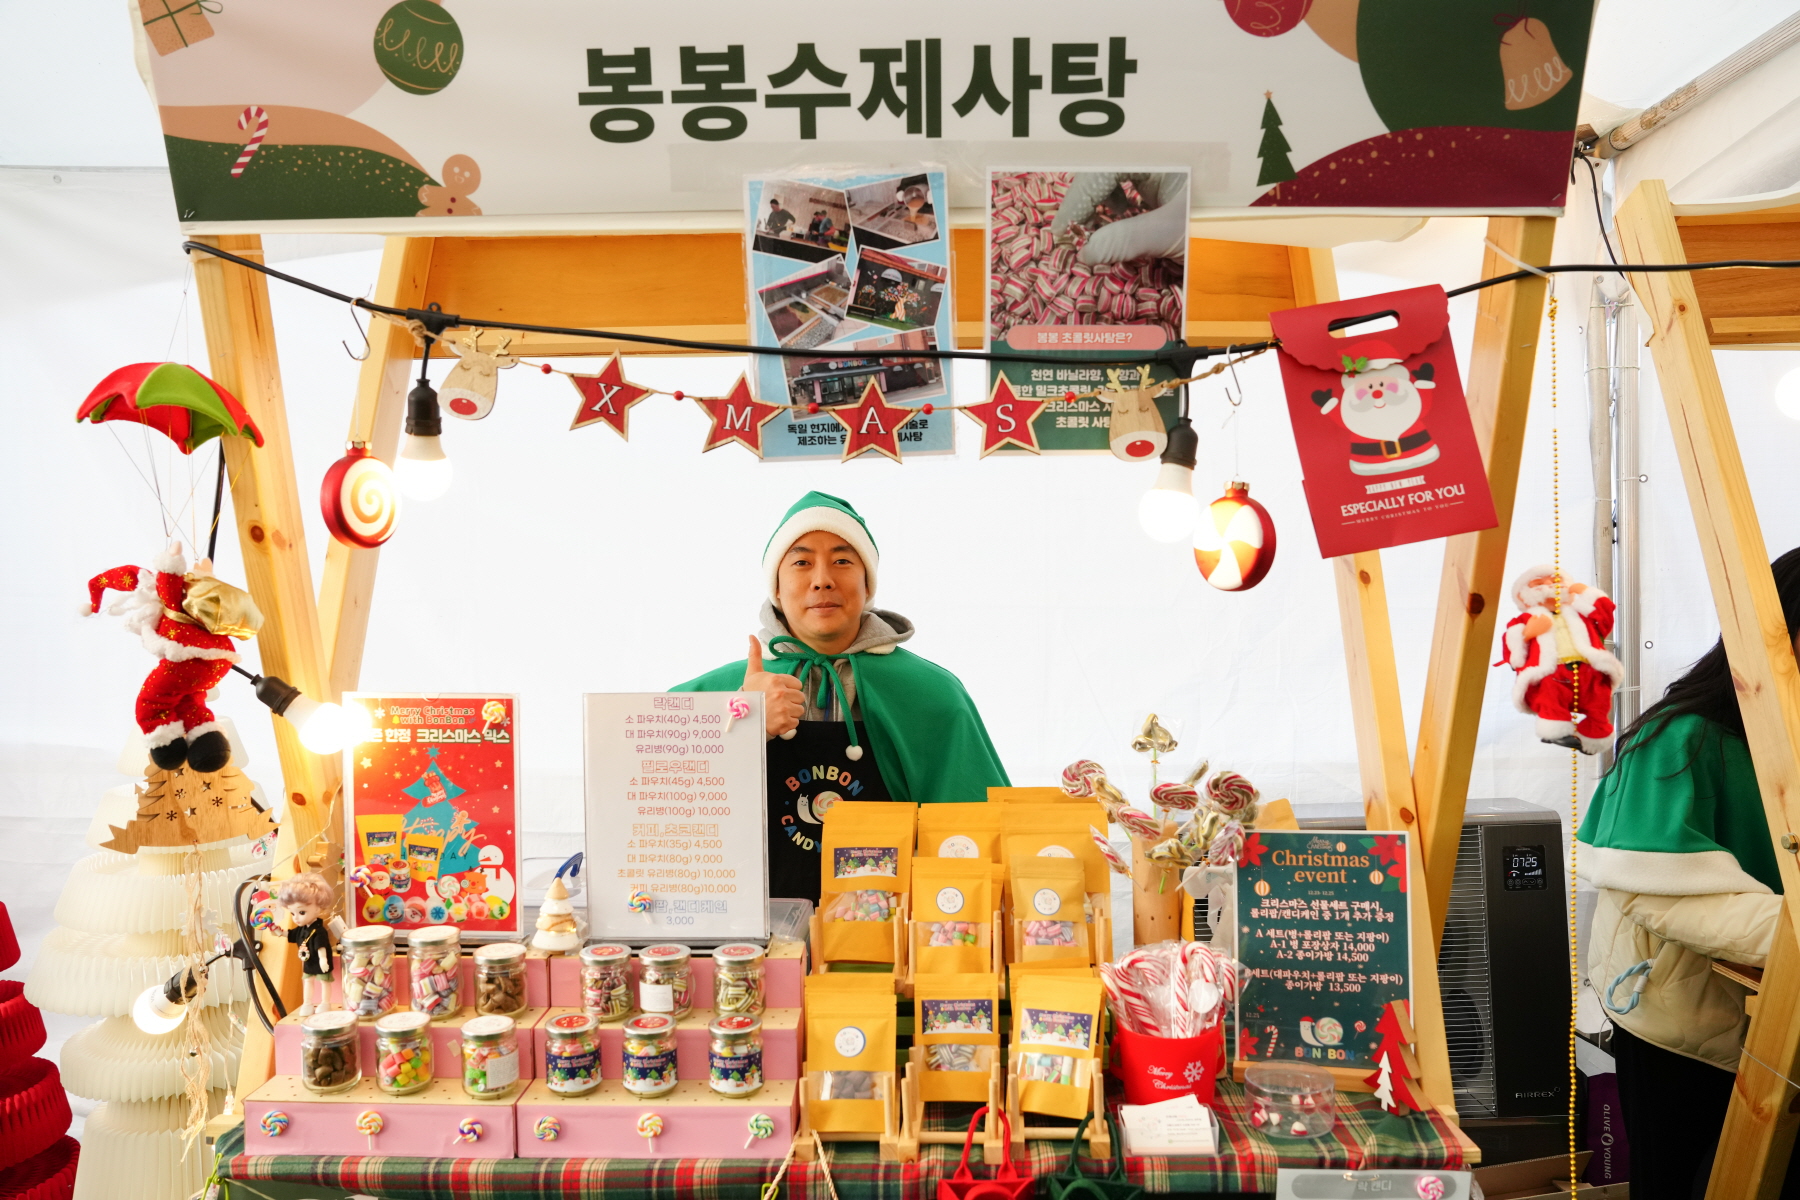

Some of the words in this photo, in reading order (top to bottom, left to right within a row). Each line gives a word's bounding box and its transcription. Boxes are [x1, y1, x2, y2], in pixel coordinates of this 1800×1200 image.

[578, 37, 1137, 143] 봉봉수제사탕
[1037, 332, 1058, 344] 봉봉
[1062, 332, 1133, 344] 초콜릿사탕은?
[1031, 369, 1053, 381] 천연
[1057, 369, 1104, 382] 바닐라향,
[1045, 400, 1100, 412] 크리스마스
[1056, 416, 1089, 428] 초콜릿
[787, 424, 807, 434] 독일
[797, 435, 837, 446] 제조하는
[1340, 495, 1405, 517] ESPECIALLY
[1408, 490, 1435, 505] FOR
[1434, 484, 1466, 499] YOU
[653, 697, 694, 710] 락캔디
[390, 706, 421, 716] Merry
[423, 706, 475, 716] Christmas
[400, 715, 424, 724] with
[425, 715, 466, 724] BonBon
[625, 715, 634, 724] 소
[637, 714, 691, 726] 파우치(40g)
[693, 715, 721, 725] 4,500
[385, 728, 411, 742] 한정
[416, 728, 482, 743] 크리스마스
[483, 728, 510, 743] 믹스
[625, 730, 634, 739] 대
[637, 729, 691, 741] 파우치(90g)
[693, 730, 721, 739] 9,000
[635, 744, 689, 756] 유리병(90g)
[691, 745, 724, 754] 10,000
[642, 760, 709, 774] 필로우캔디
[629, 777, 638, 786] 소
[641, 777, 695, 788] 파우치(45g)
[697, 777, 725, 786] 4,500
[785, 765, 864, 796] BONBON
[627, 792, 636, 801] 대
[639, 791, 697, 803] 파우치(100g)
[699, 792, 727, 801] 9,000
[637, 806, 696, 818] 유리병(100g)
[698, 807, 731, 817] 10,000
[632, 823, 719, 837] 커피,초코캔디
[627, 840, 636, 848] 소
[639, 839, 692, 850] 파우치(35g)
[694, 840, 722, 849] 4,500
[627, 854, 636, 863] 대
[639, 854, 693, 865] 파우치(80g)
[694, 854, 723, 863] 9,000
[1272, 849, 1370, 868] Christmas
[617, 869, 645, 878] 초콜릿
[647, 869, 700, 880] 유리병(80g)
[703, 869, 736, 879] 10,000
[1294, 869, 1347, 883] event
[1260, 899, 1308, 909] 크리스마스
[1310, 900, 1348, 910] 선물세트
[1350, 901, 1383, 912] 구매시,
[666, 916, 694, 926] 3,000
[1322, 910, 1332, 921] 중
[1334, 911, 1350, 921] 1개
[1352, 911, 1372, 922] 추가
[1374, 912, 1394, 923] 증정
[1255, 929, 1263, 938] A
[1334, 931, 1354, 941] 또는
[1356, 932, 1390, 943] 지팡이)
[1270, 939, 1287, 948] A-1
[1289, 940, 1299, 950] 병
[1301, 939, 1340, 951] 포장상자
[1343, 943, 1375, 952] 14,000
[1276, 951, 1293, 959] A-2
[1295, 950, 1334, 961] 종이가방
[1336, 952, 1369, 963] 14,500
[1347, 973, 1367, 983] 또는
[1370, 974, 1403, 985] 지팡이)
[1285, 981, 1323, 992] 종이가방
[1328, 982, 1361, 993] 13,500
[1147, 1065, 1173, 1080] Merry
[1515, 1091, 1555, 1099] AIRREX
[1603, 1104, 1611, 1131] OLIVE
[1371, 1180, 1392, 1191] 캔디
